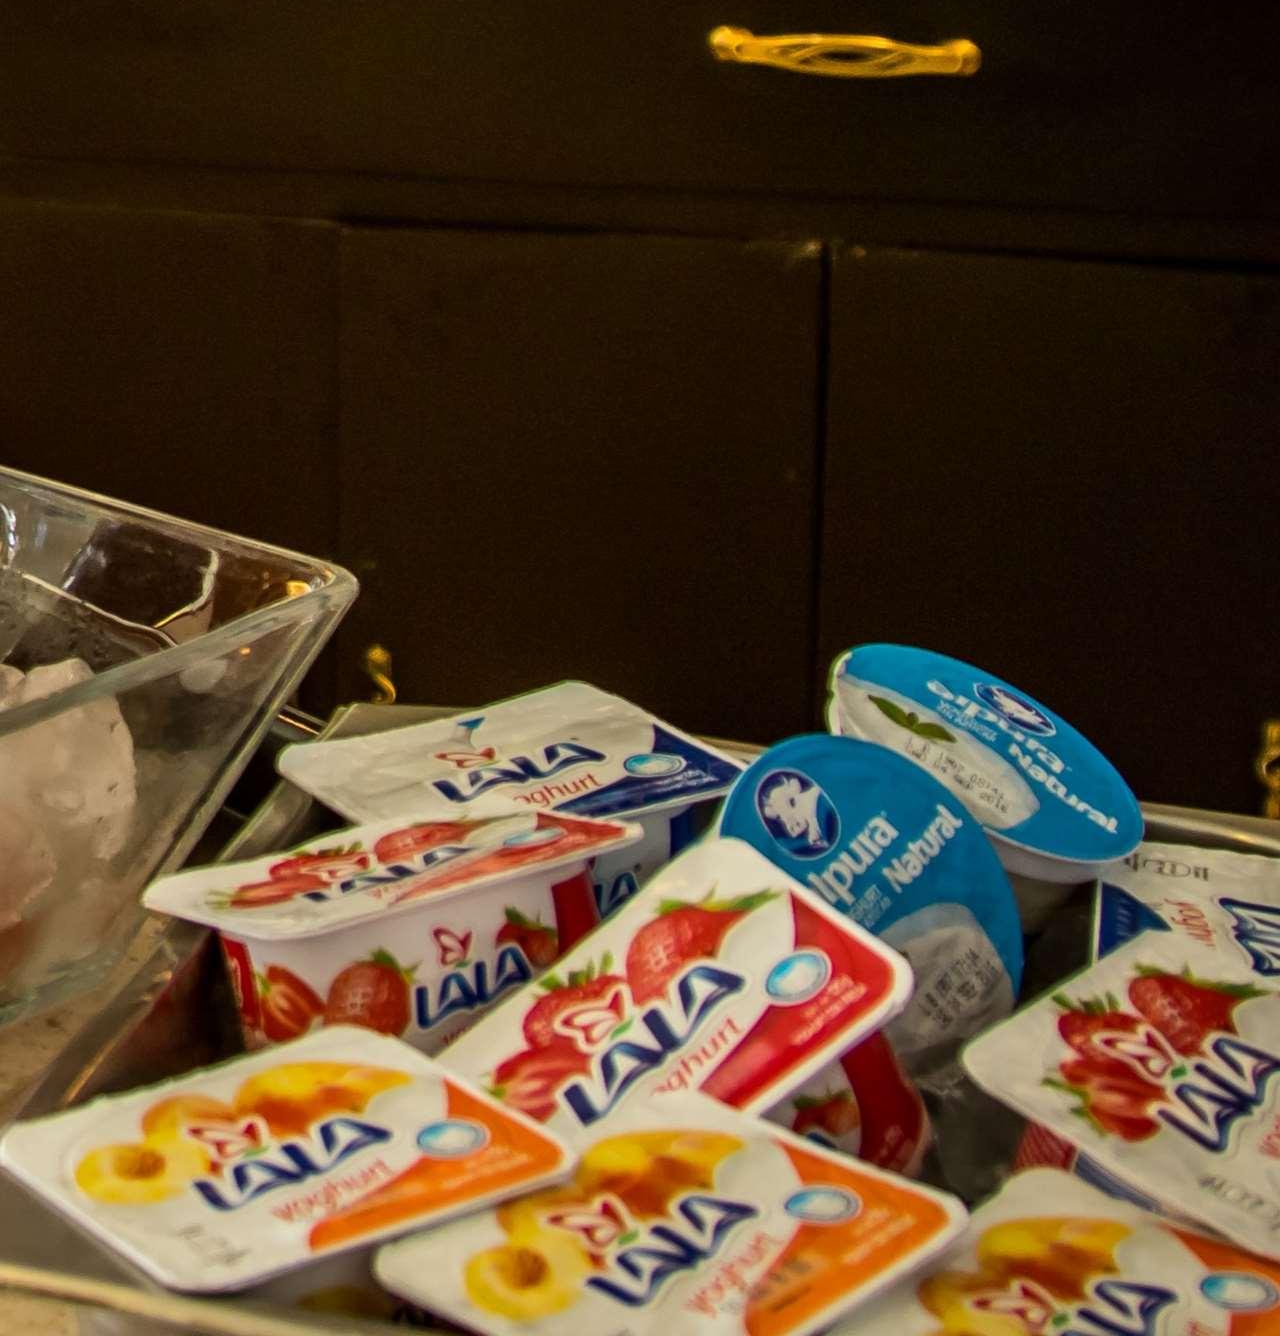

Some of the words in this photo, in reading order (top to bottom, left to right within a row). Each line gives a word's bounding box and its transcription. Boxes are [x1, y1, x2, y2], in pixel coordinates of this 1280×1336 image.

[432, 742, 607, 803] LALA
[1008, 742, 1118, 835] Natural
[807, 815, 901, 906] lpura
[882, 803, 964, 894] Natural
[414, 945, 534, 1031] LALA
[562, 964, 747, 1127] LALA
[193, 1116, 394, 1212] LALA
[272, 1158, 395, 1224] yoghurt
[587, 1195, 760, 1307] LALA
